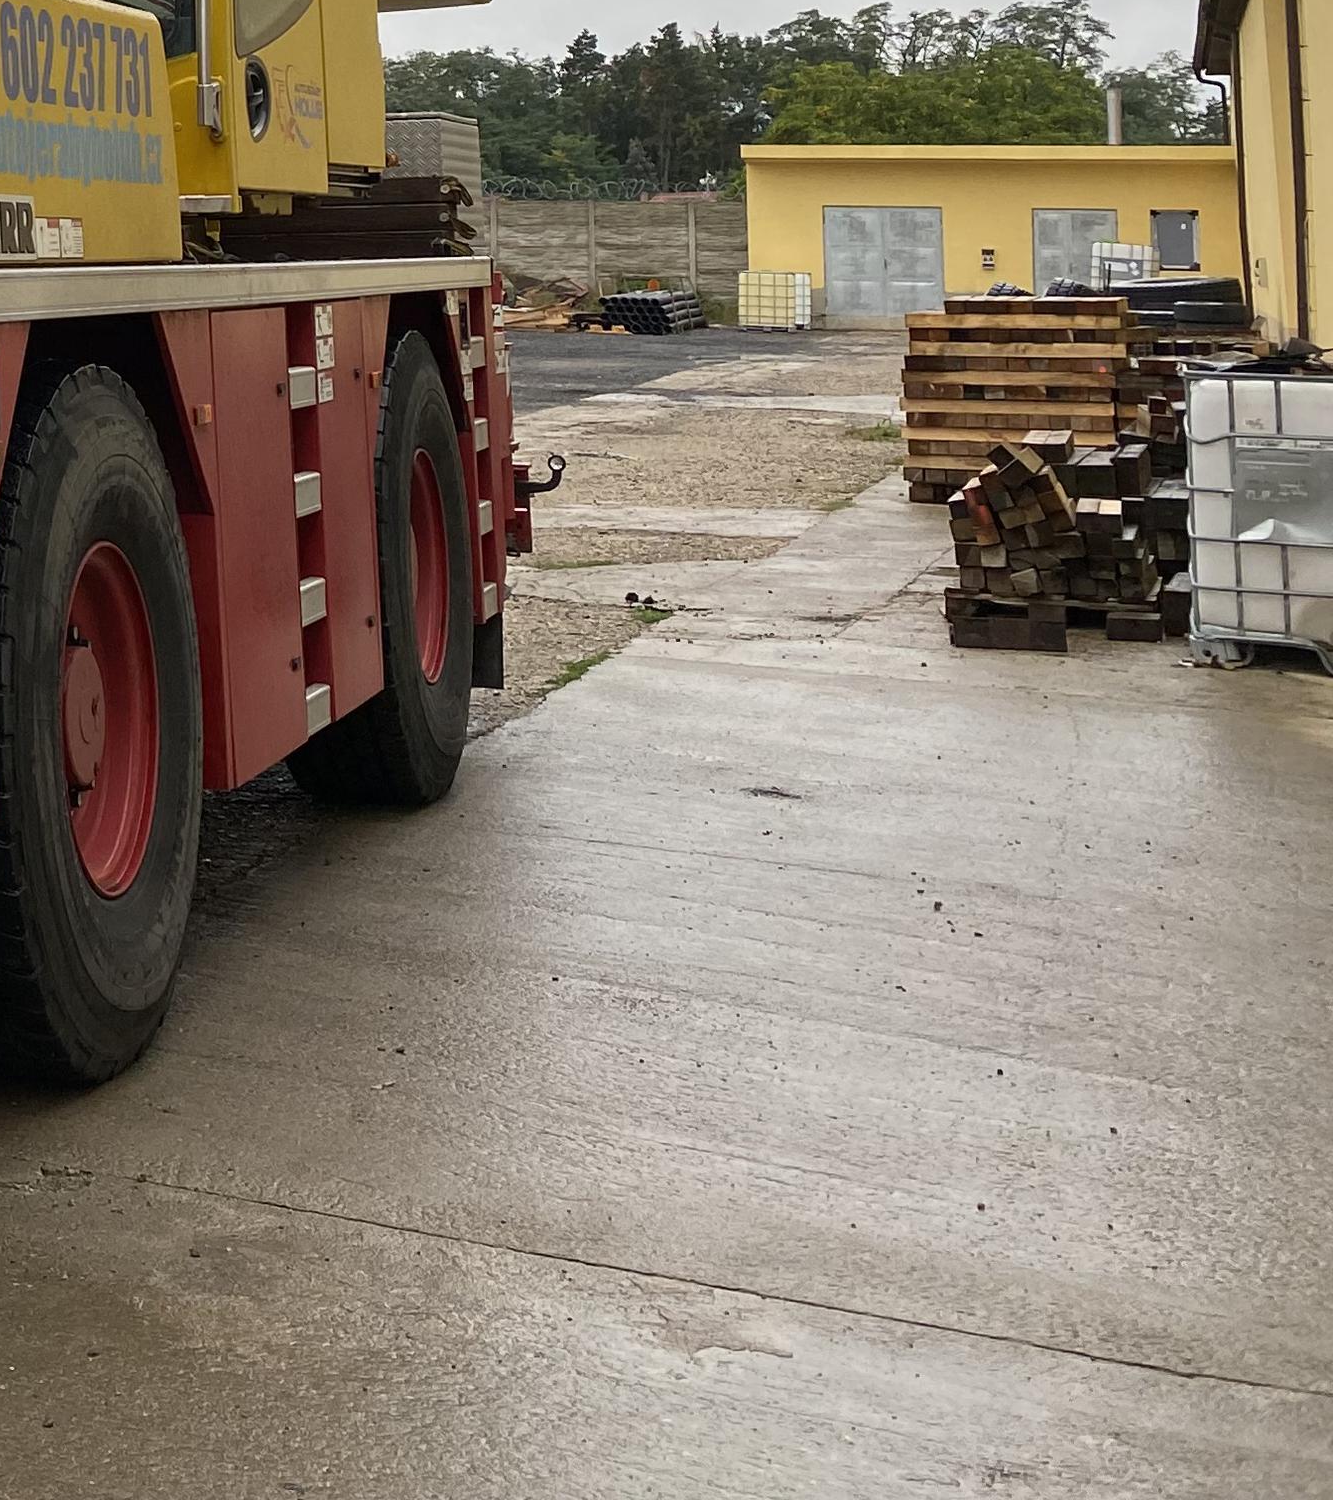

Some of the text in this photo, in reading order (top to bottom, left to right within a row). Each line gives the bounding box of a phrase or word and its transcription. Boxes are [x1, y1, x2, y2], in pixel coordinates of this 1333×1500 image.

[0, 1, 57, 105] 602
[61, 14, 106, 113] 237
[109, 23, 153, 118] 731
